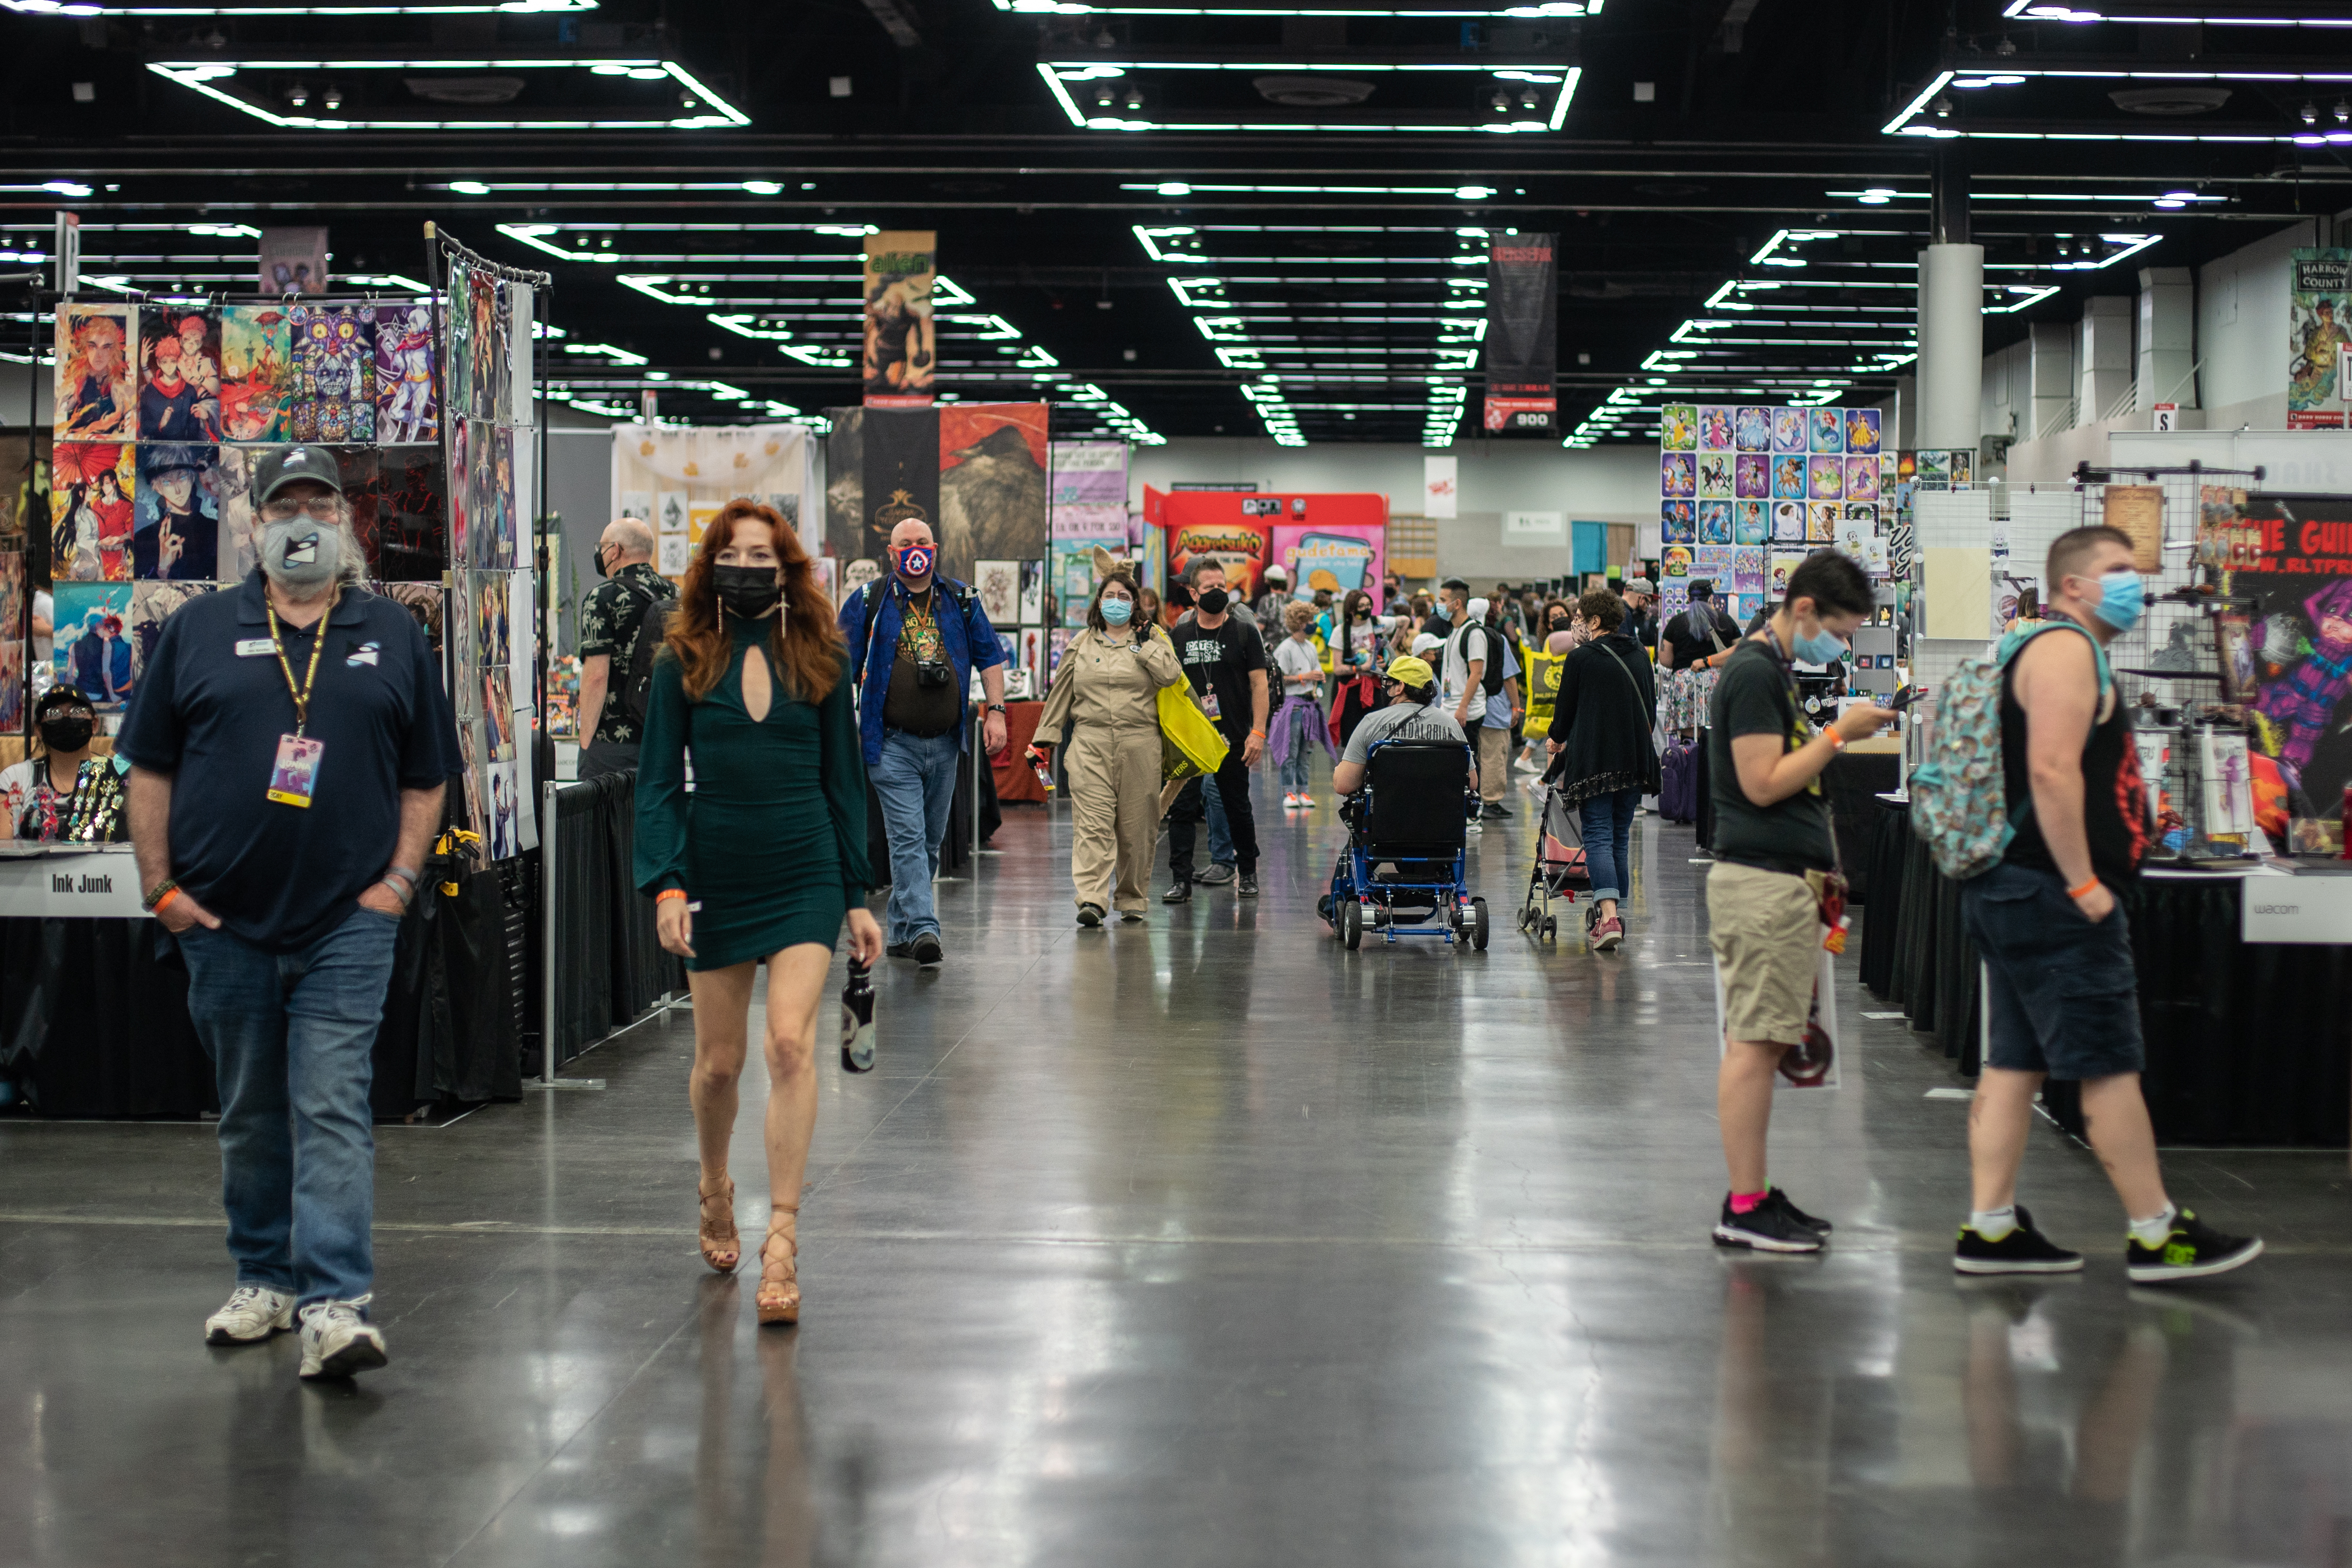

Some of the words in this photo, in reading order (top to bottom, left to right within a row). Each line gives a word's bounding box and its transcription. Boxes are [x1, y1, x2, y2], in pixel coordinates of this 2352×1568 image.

[2302, 264, 2348, 276] HARROW
[2302, 276, 2346, 288] COUNTY
[2160, 413, 2168, 431] S
[1286, 541, 1369, 563] gudetama
[52, 874, 73, 893] Ink
[78, 874, 112, 893] Junk
[2254, 905, 2299, 915] wacom
